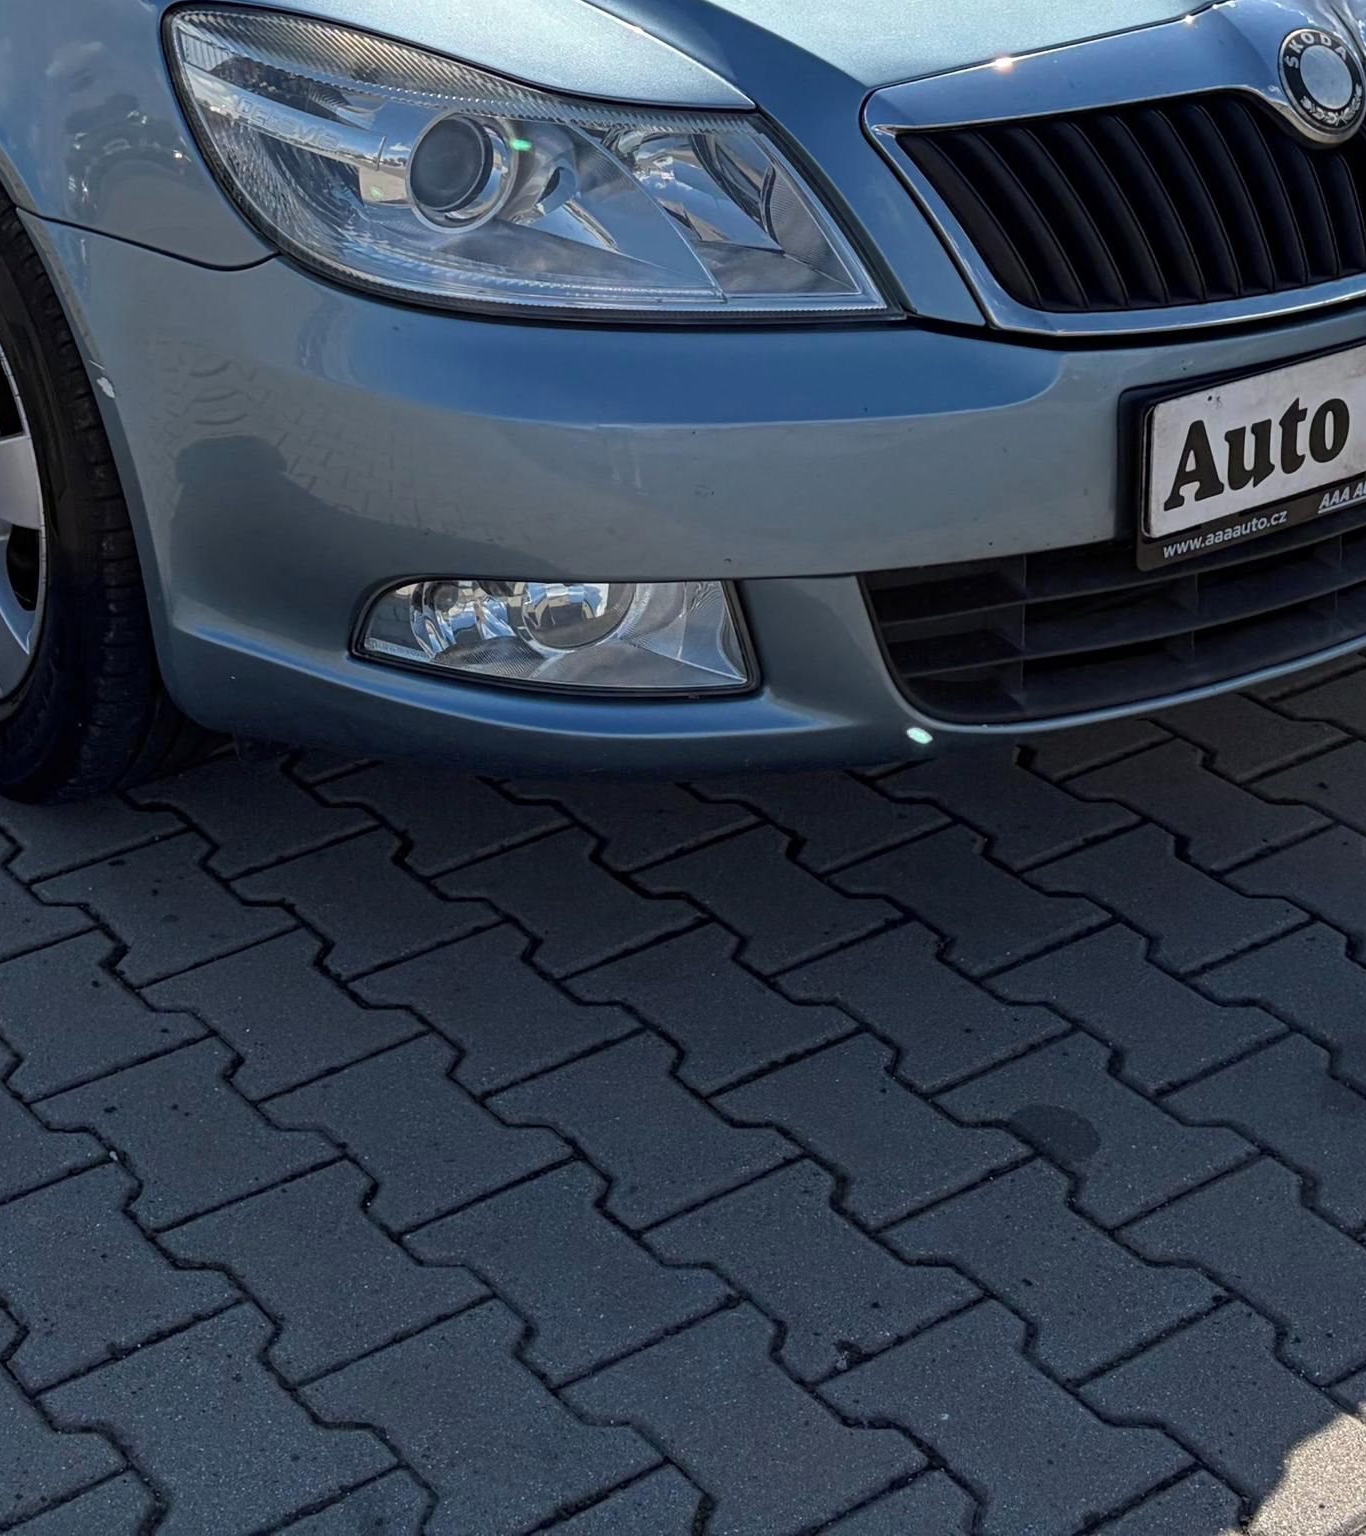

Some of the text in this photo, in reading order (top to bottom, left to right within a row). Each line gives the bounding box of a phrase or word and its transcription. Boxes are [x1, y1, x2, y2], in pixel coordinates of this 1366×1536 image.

[1163, 396, 1350, 511] Auto
[1318, 486, 1350, 510] AAA
[1163, 510, 1288, 559] www.aaaauto.cz
